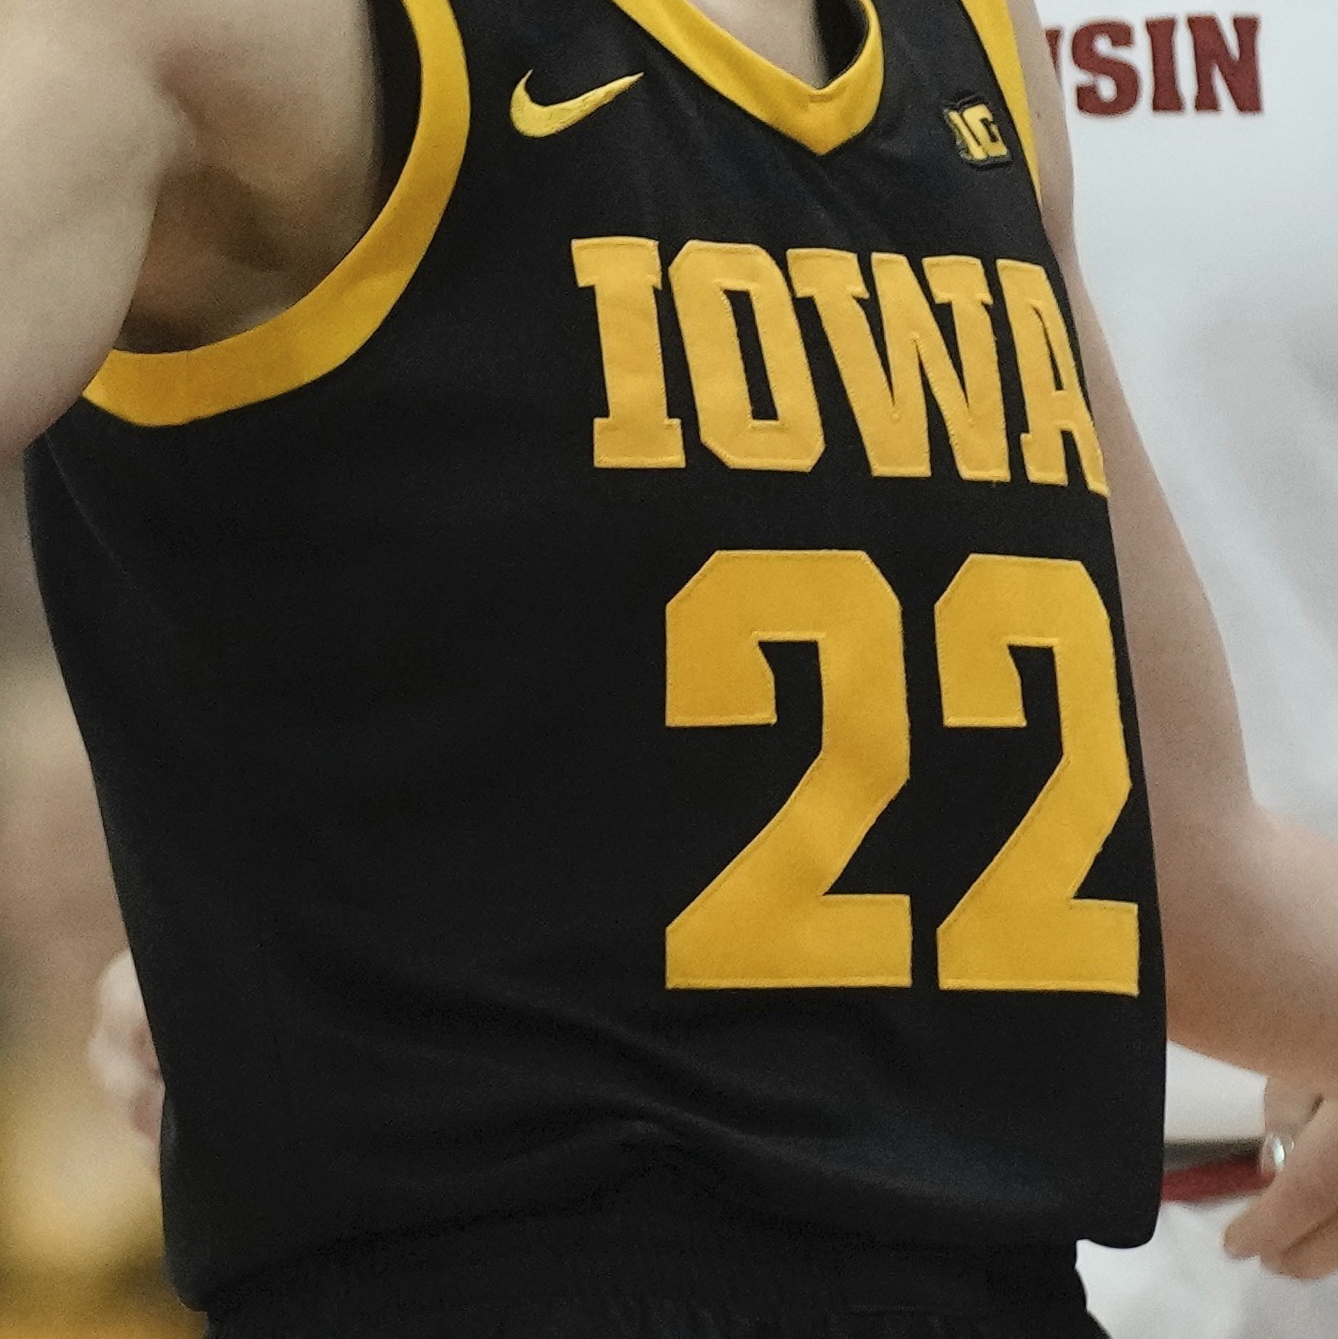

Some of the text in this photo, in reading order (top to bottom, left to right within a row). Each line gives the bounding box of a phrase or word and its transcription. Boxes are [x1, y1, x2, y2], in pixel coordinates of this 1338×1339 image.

[1045, 16, 1261, 115] SIN
[571, 236, 1108, 497] IOWA
[665, 549, 1139, 996] 22
